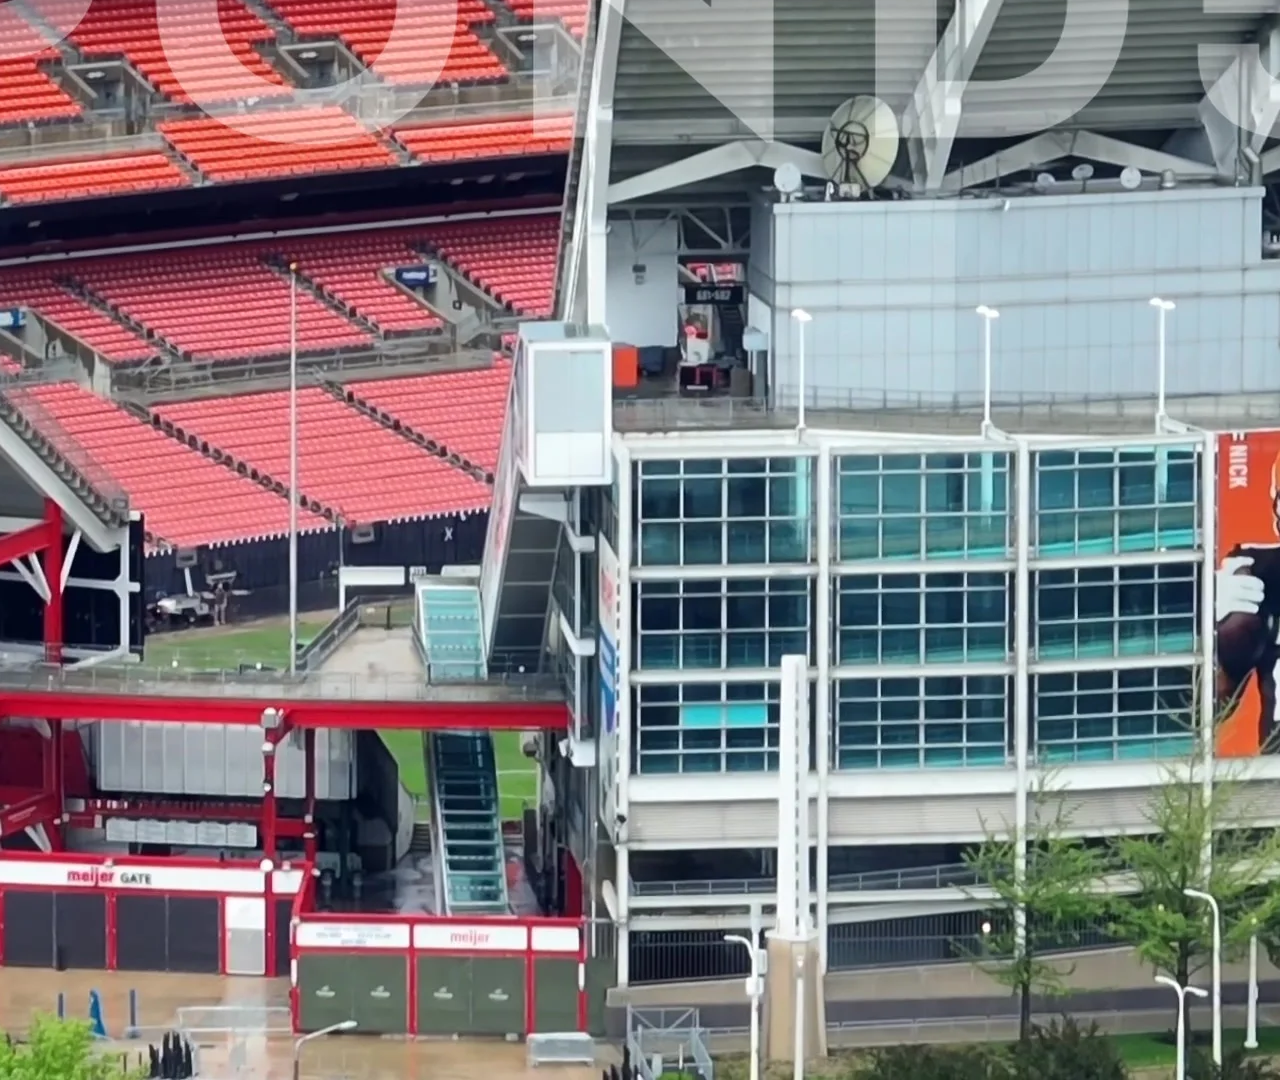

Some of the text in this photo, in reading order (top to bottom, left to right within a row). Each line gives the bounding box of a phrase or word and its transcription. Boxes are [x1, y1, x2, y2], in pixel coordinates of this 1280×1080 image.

[1228, 445, 1248, 489] NICK
[66, 867, 152, 885] meijer GATE
[449, 930, 491, 946] meijer
